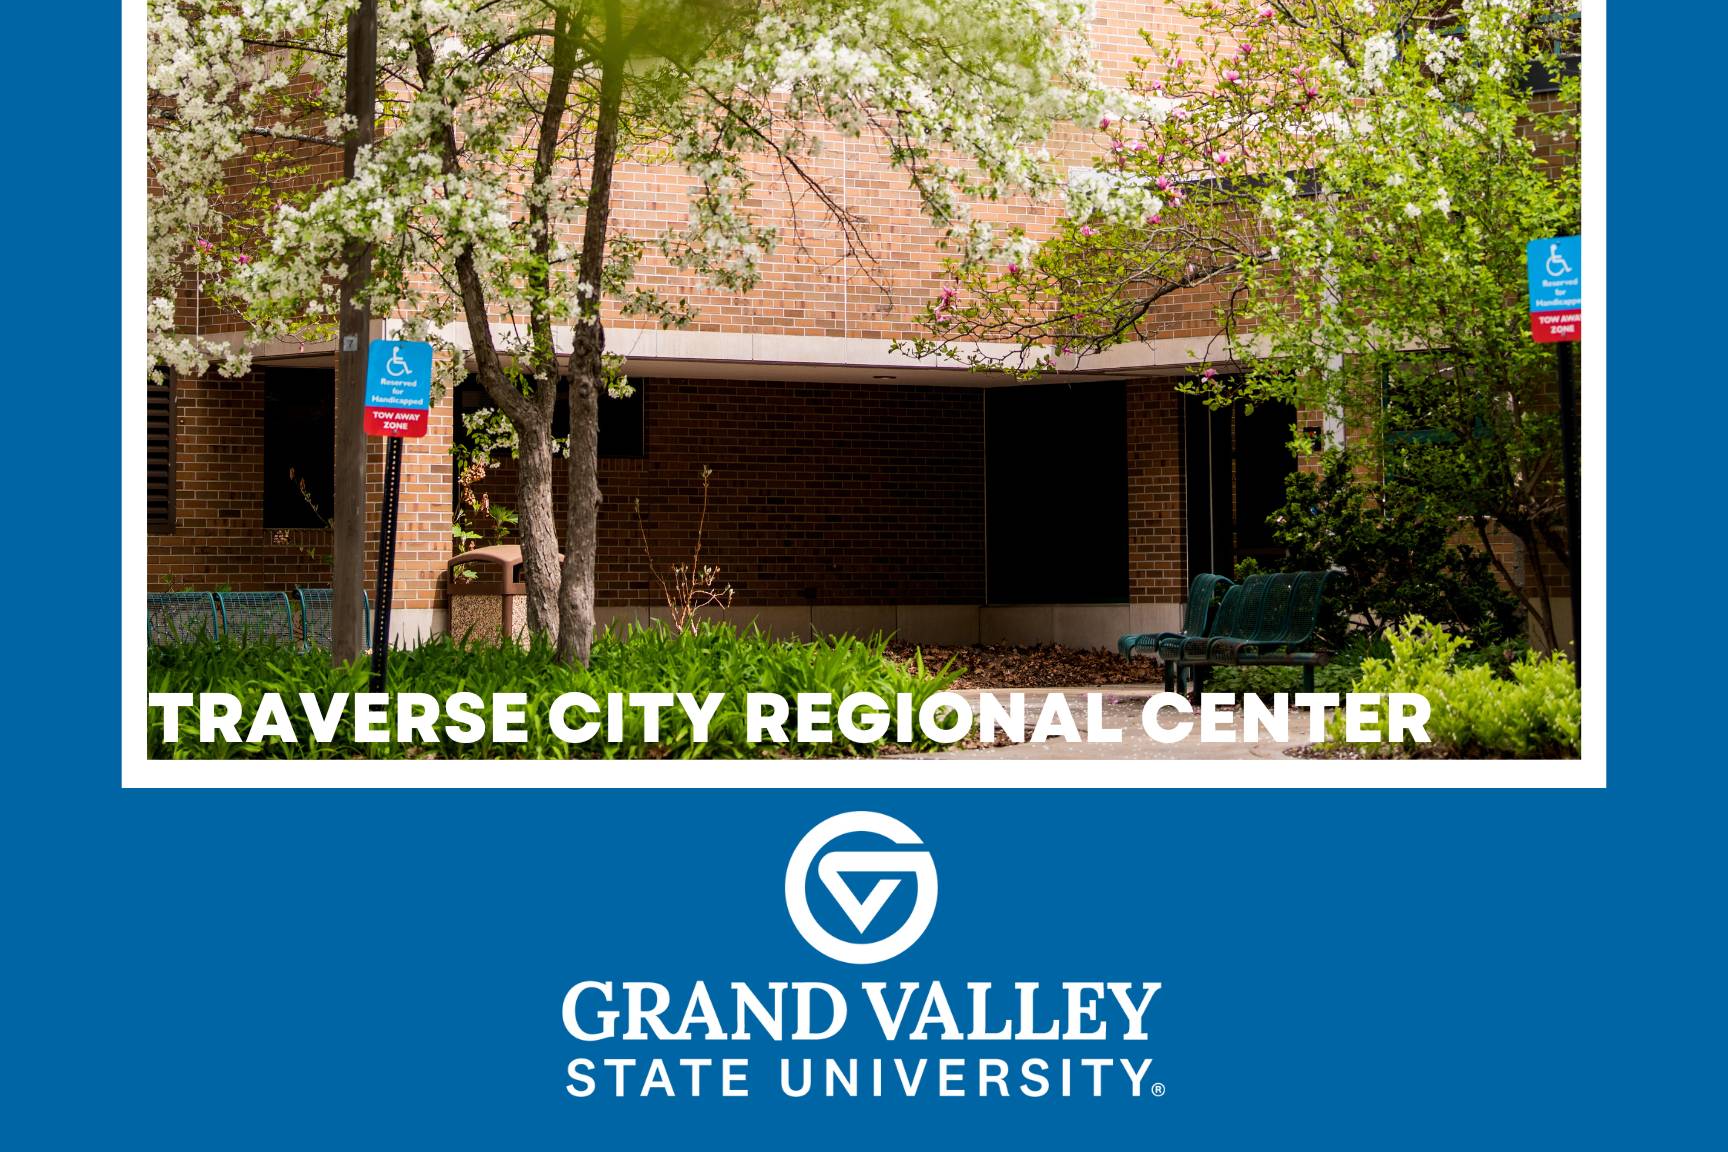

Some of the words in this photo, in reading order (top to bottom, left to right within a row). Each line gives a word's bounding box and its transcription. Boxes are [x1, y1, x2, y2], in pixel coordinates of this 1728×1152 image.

[1554, 288, 1566, 296] for
[1538, 316, 1560, 324] TOW
[1550, 325, 1575, 334] ZONE
[380, 378, 417, 387] Reserved
[392, 387, 404, 395] for
[371, 395, 424, 406] Handicapped
[372, 411, 394, 419] TOW
[394, 413, 420, 421] AWAY
[383, 421, 409, 430] ZONE
